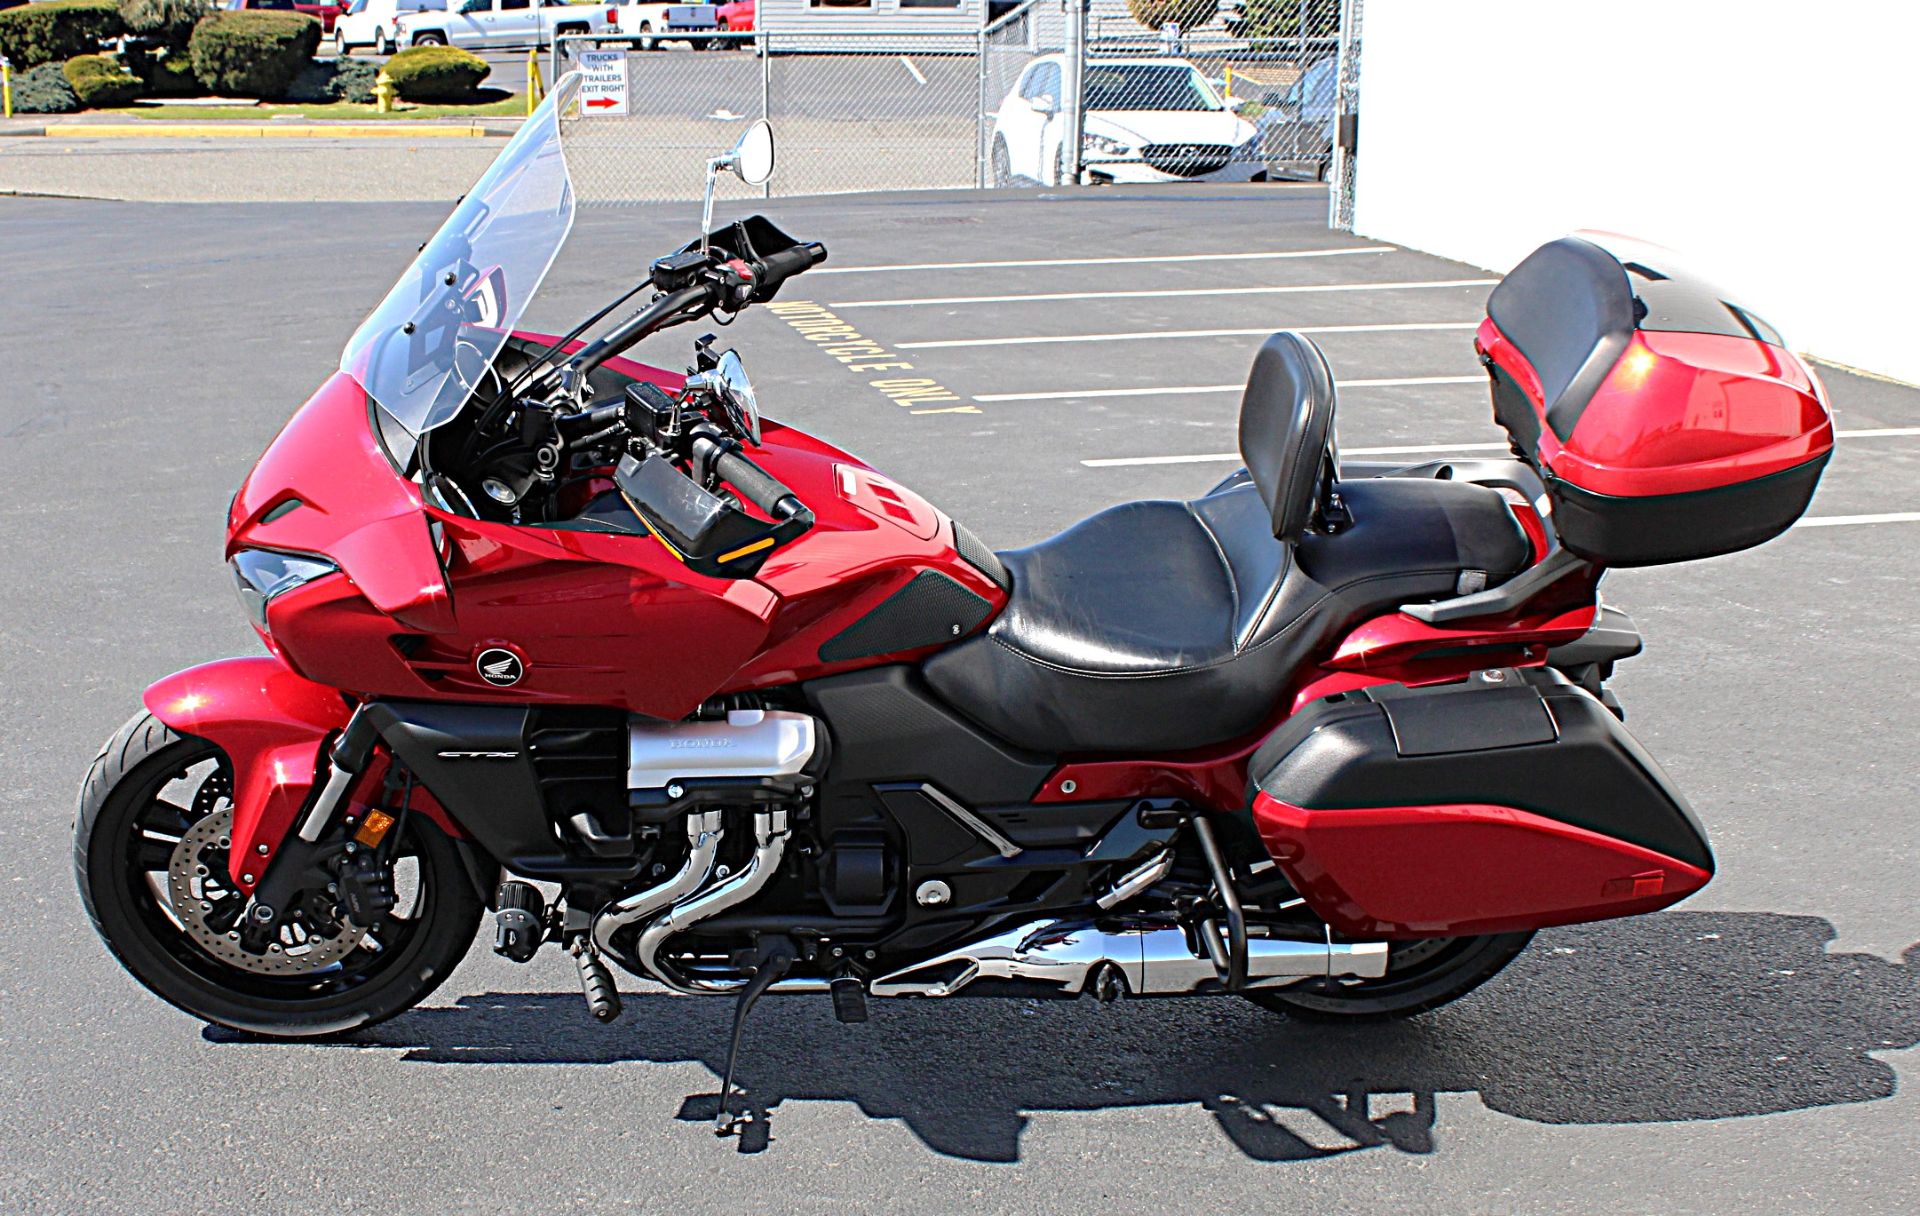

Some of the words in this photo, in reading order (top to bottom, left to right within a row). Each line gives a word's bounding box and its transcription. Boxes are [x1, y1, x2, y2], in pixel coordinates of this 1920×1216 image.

[586, 53, 618, 62] TRUCKS
[592, 64, 613, 72] WITH
[584, 74, 622, 82] TRAILERS
[581, 85, 599, 93] EXIT
[601, 85, 625, 93] RIGHT
[764, 300, 914, 372] MOTORCYCLE
[869, 378, 983, 415] ONLY
[484, 672, 517, 680] HONDA
